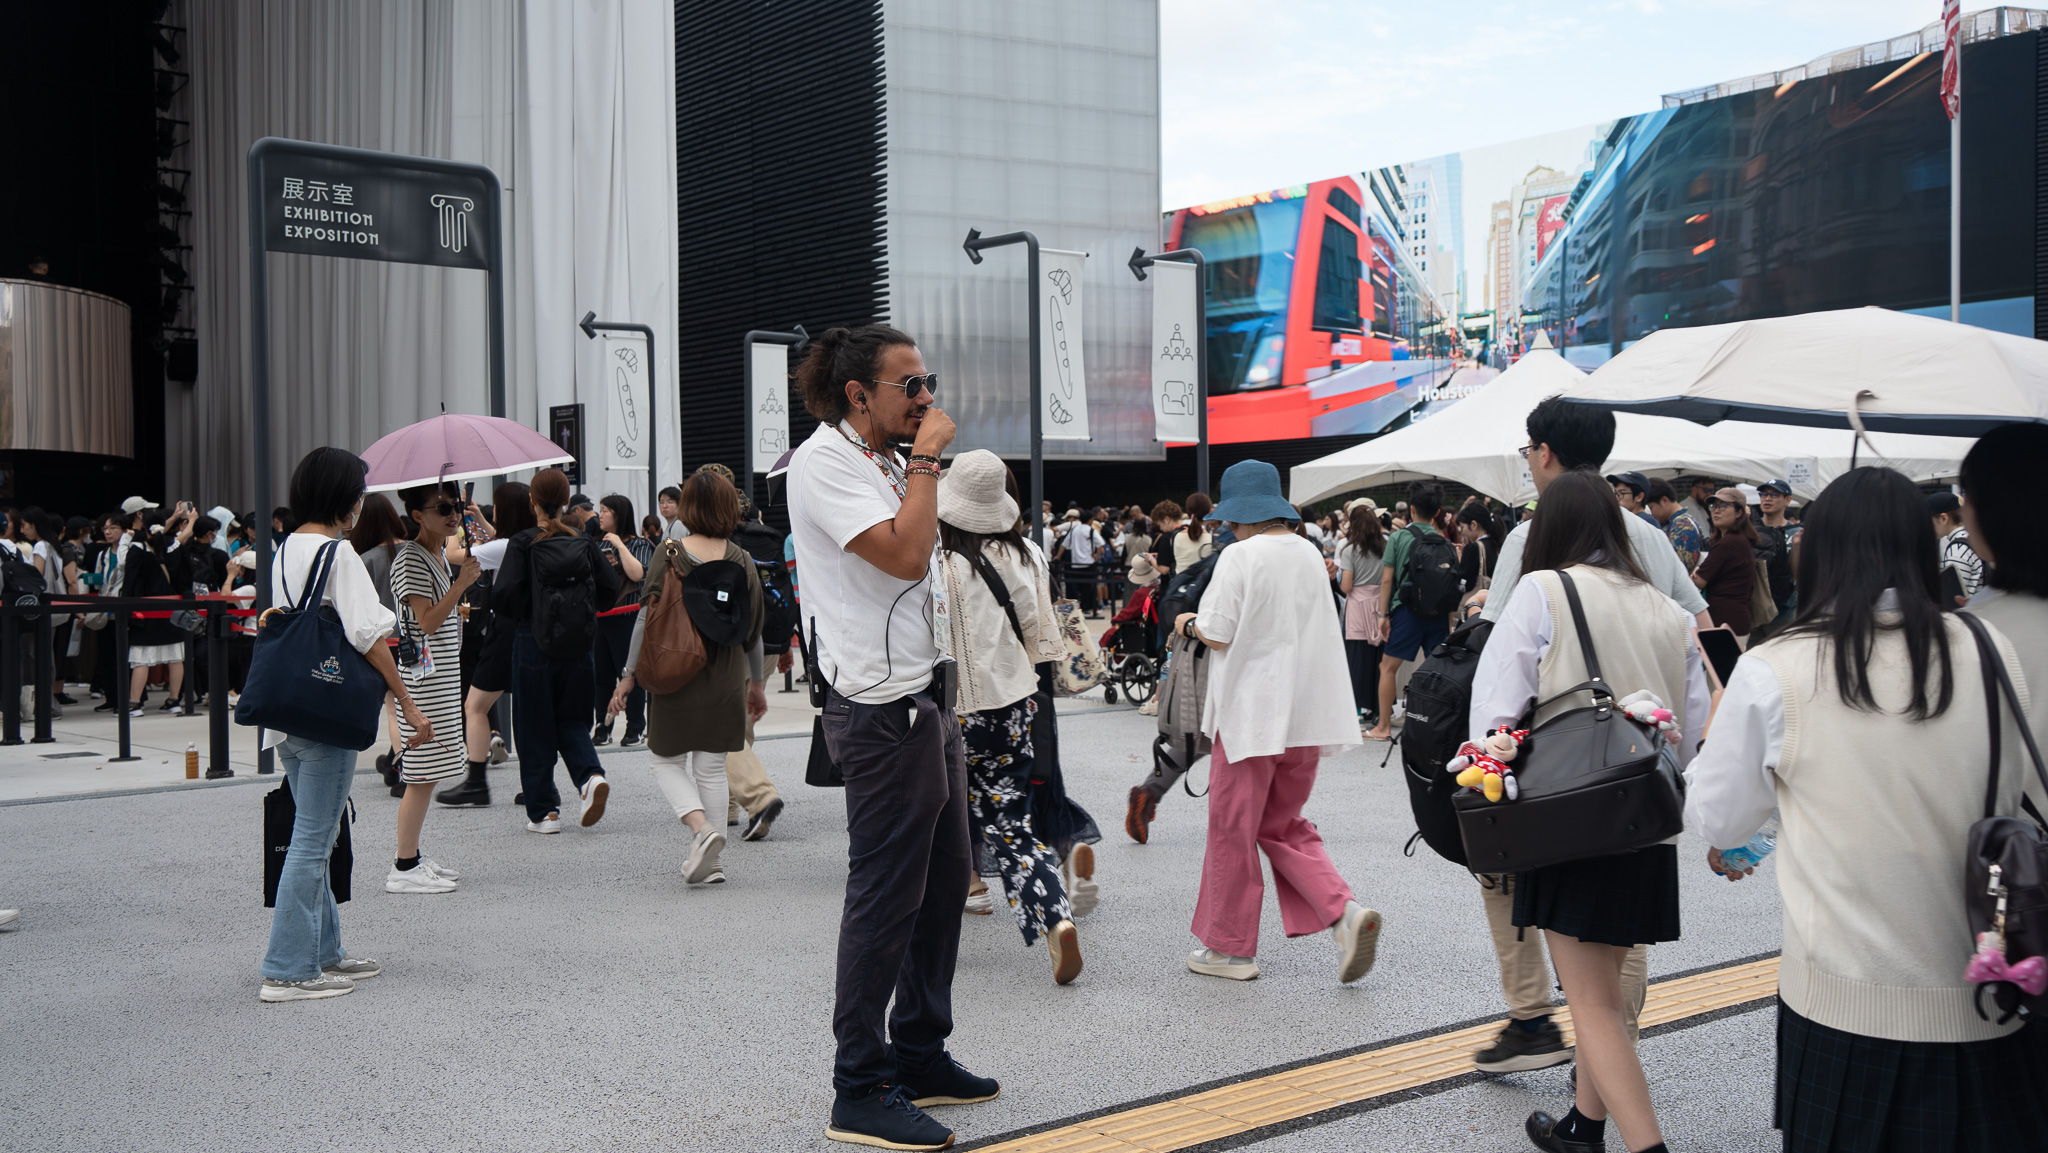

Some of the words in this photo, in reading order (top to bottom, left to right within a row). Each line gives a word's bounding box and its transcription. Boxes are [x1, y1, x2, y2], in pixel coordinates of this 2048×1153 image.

[282, 177, 354, 206] 展示室
[284, 206, 373, 227] EXHIBITION
[284, 225, 379, 246] EXPOSITION
